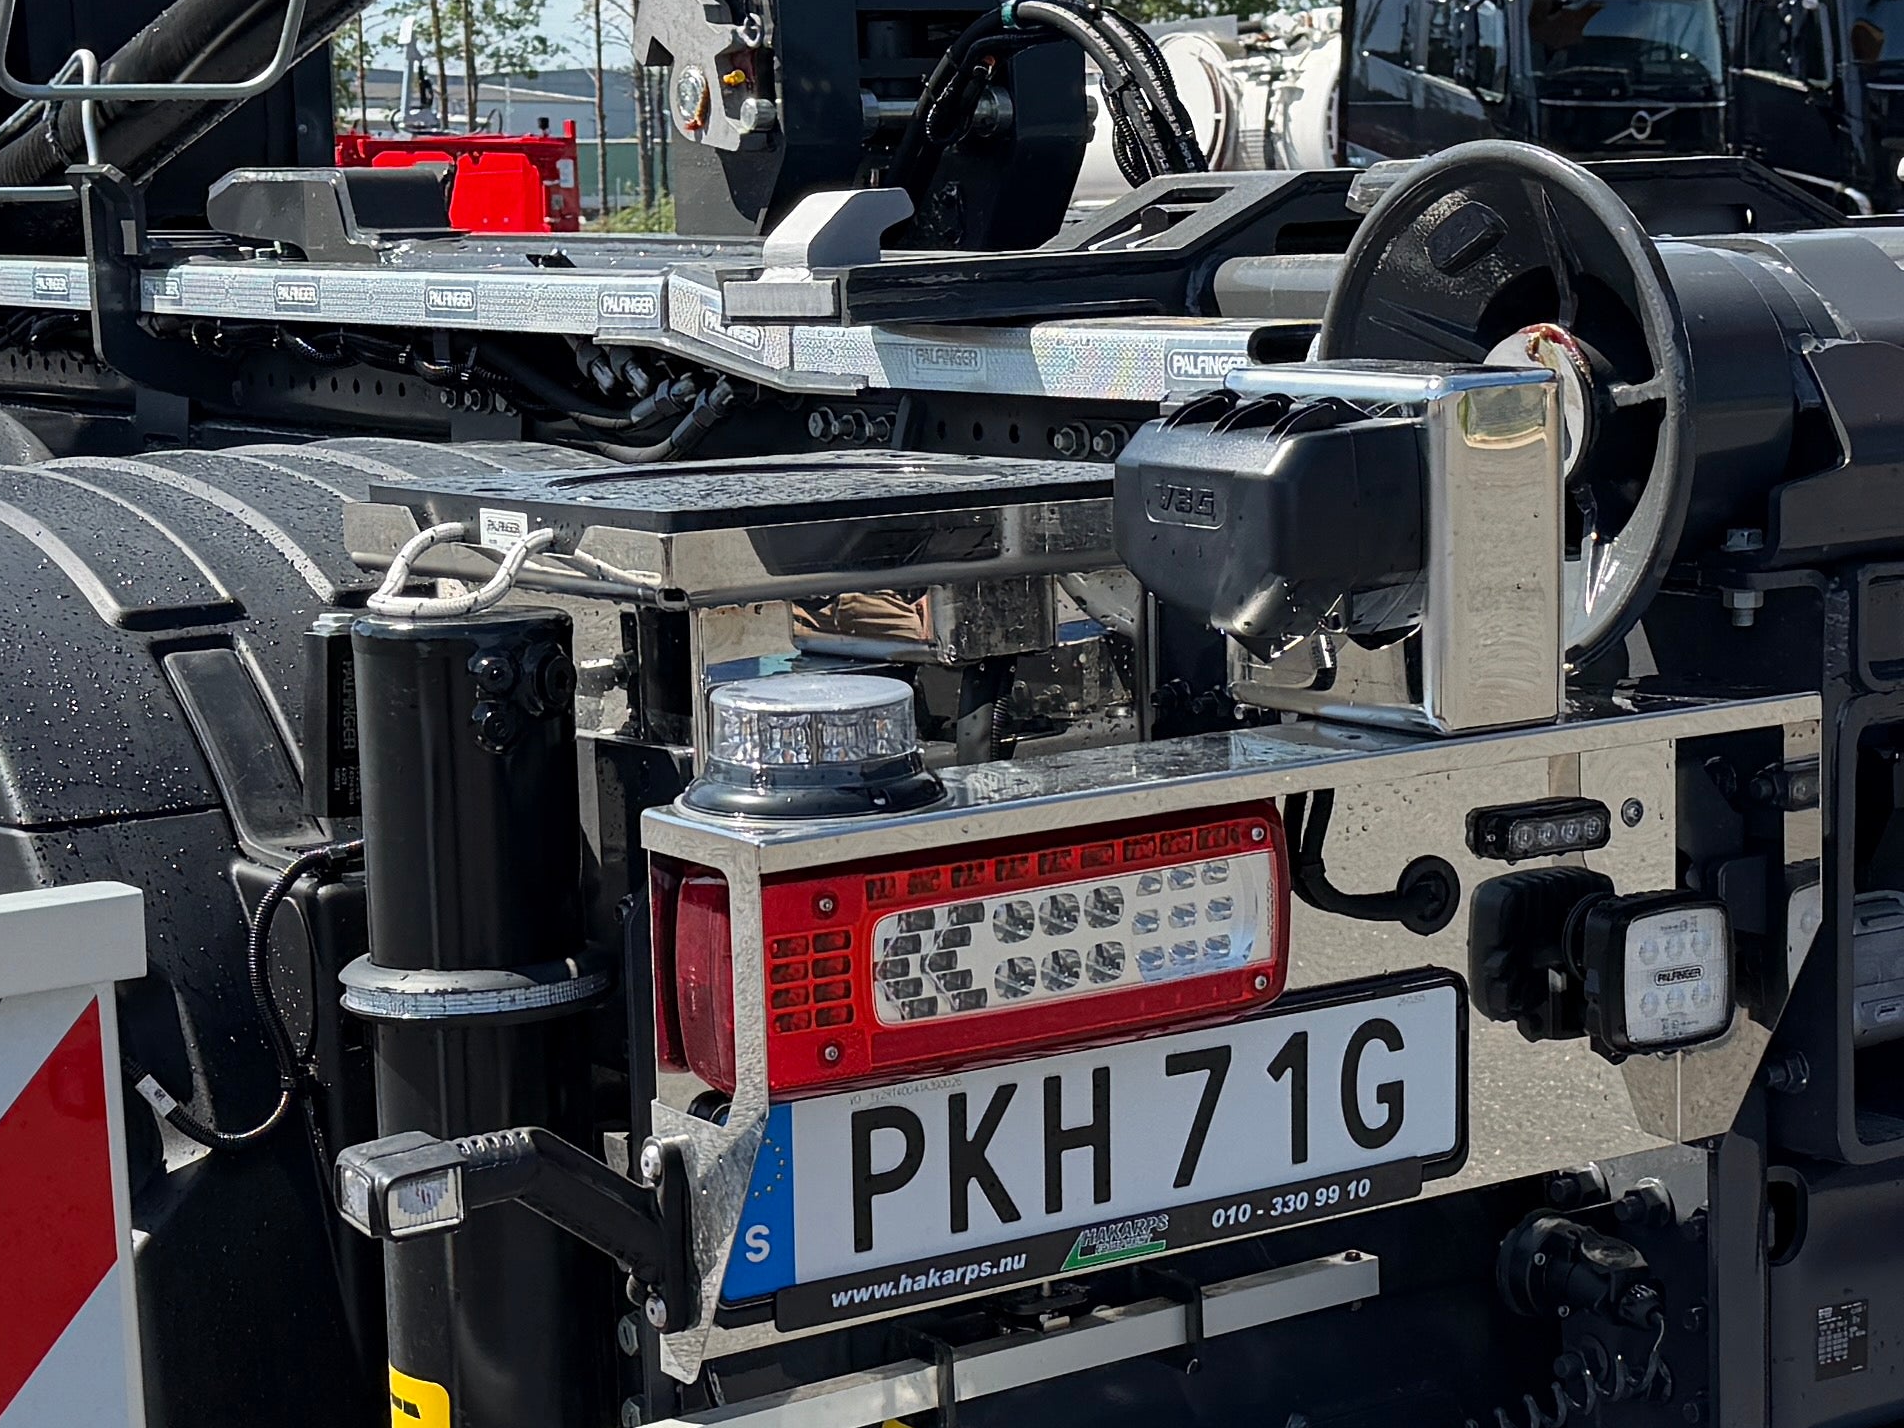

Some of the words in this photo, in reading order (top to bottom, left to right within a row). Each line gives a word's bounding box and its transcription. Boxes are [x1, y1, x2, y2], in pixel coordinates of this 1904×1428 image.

[428, 287, 474, 309] PALFINGER
[601, 293, 655, 315] PALFINGER
[914, 346, 978, 368] PALFINGER
[851, 1065, 1112, 1254] PKH
[1164, 1016, 1406, 1189] 71G
[1211, 1203, 1251, 1229] 010
[1270, 1191, 1309, 1219] 330
[1313, 1184, 1340, 1207] 99
[1345, 1177, 1371, 1201] 10
[744, 1224, 771, 1263] S
[1082, 1213, 1169, 1247] HAKARPS
[831, 1250, 1027, 1309] www.hakarps.nu
